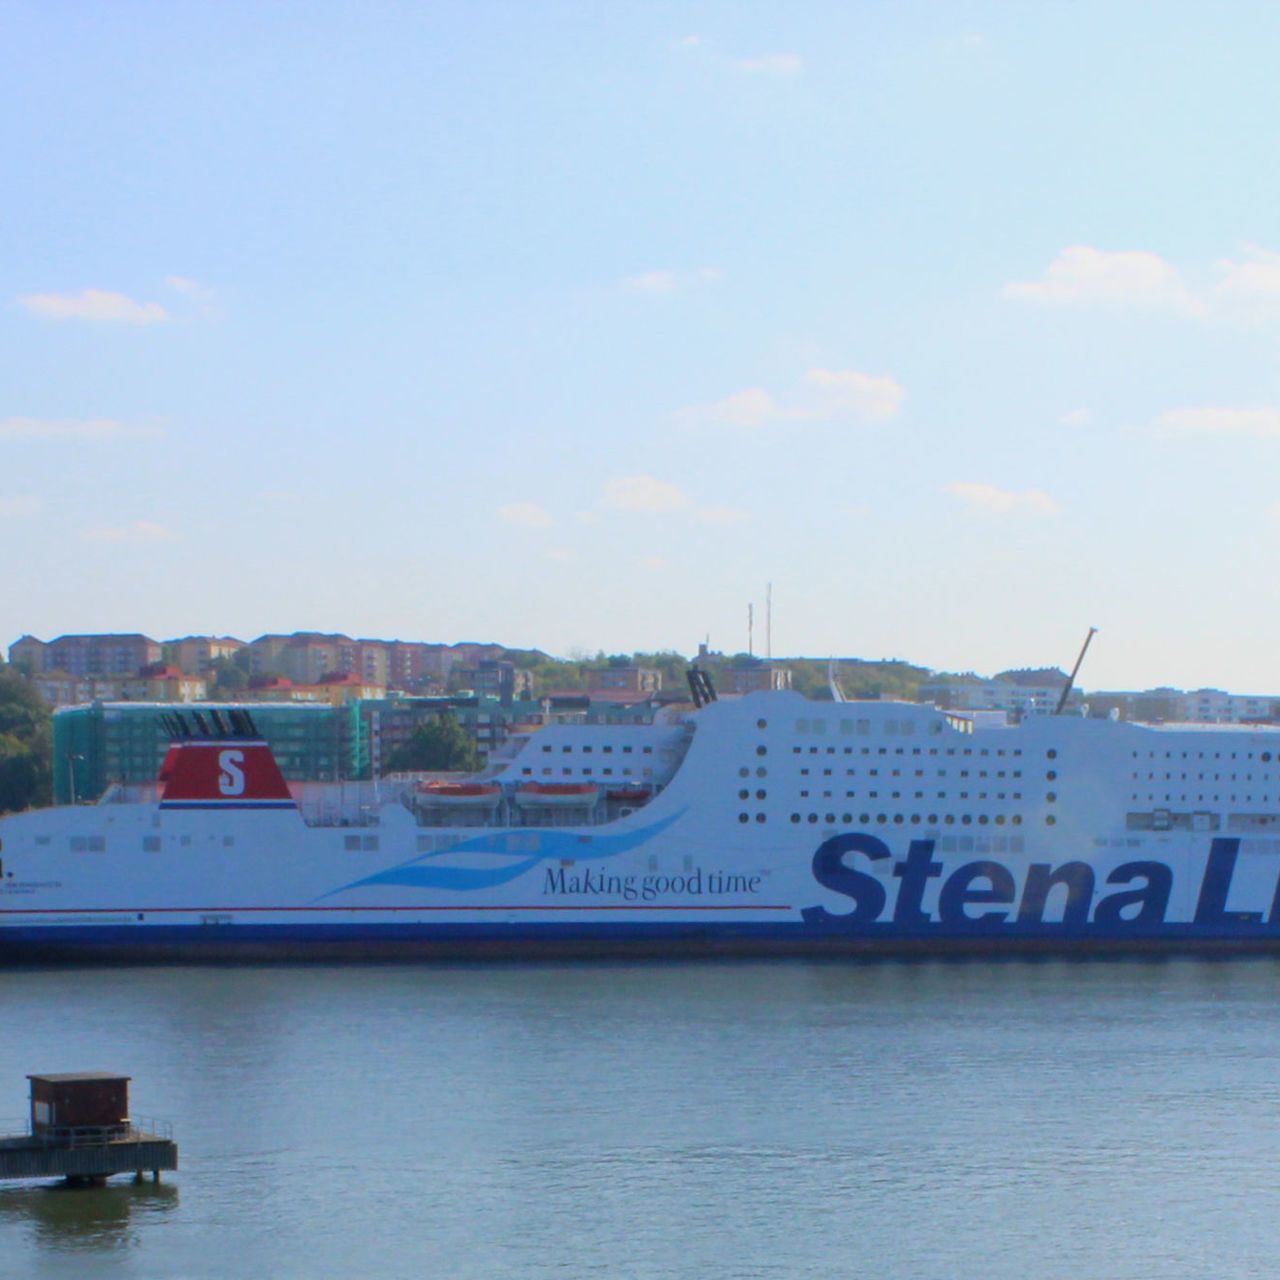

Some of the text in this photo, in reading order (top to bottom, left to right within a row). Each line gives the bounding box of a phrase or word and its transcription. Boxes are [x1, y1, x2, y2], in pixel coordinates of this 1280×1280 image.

[218, 750, 246, 796] S
[543, 867, 761, 900] Making good time
[801, 832, 1174, 924] Stena
